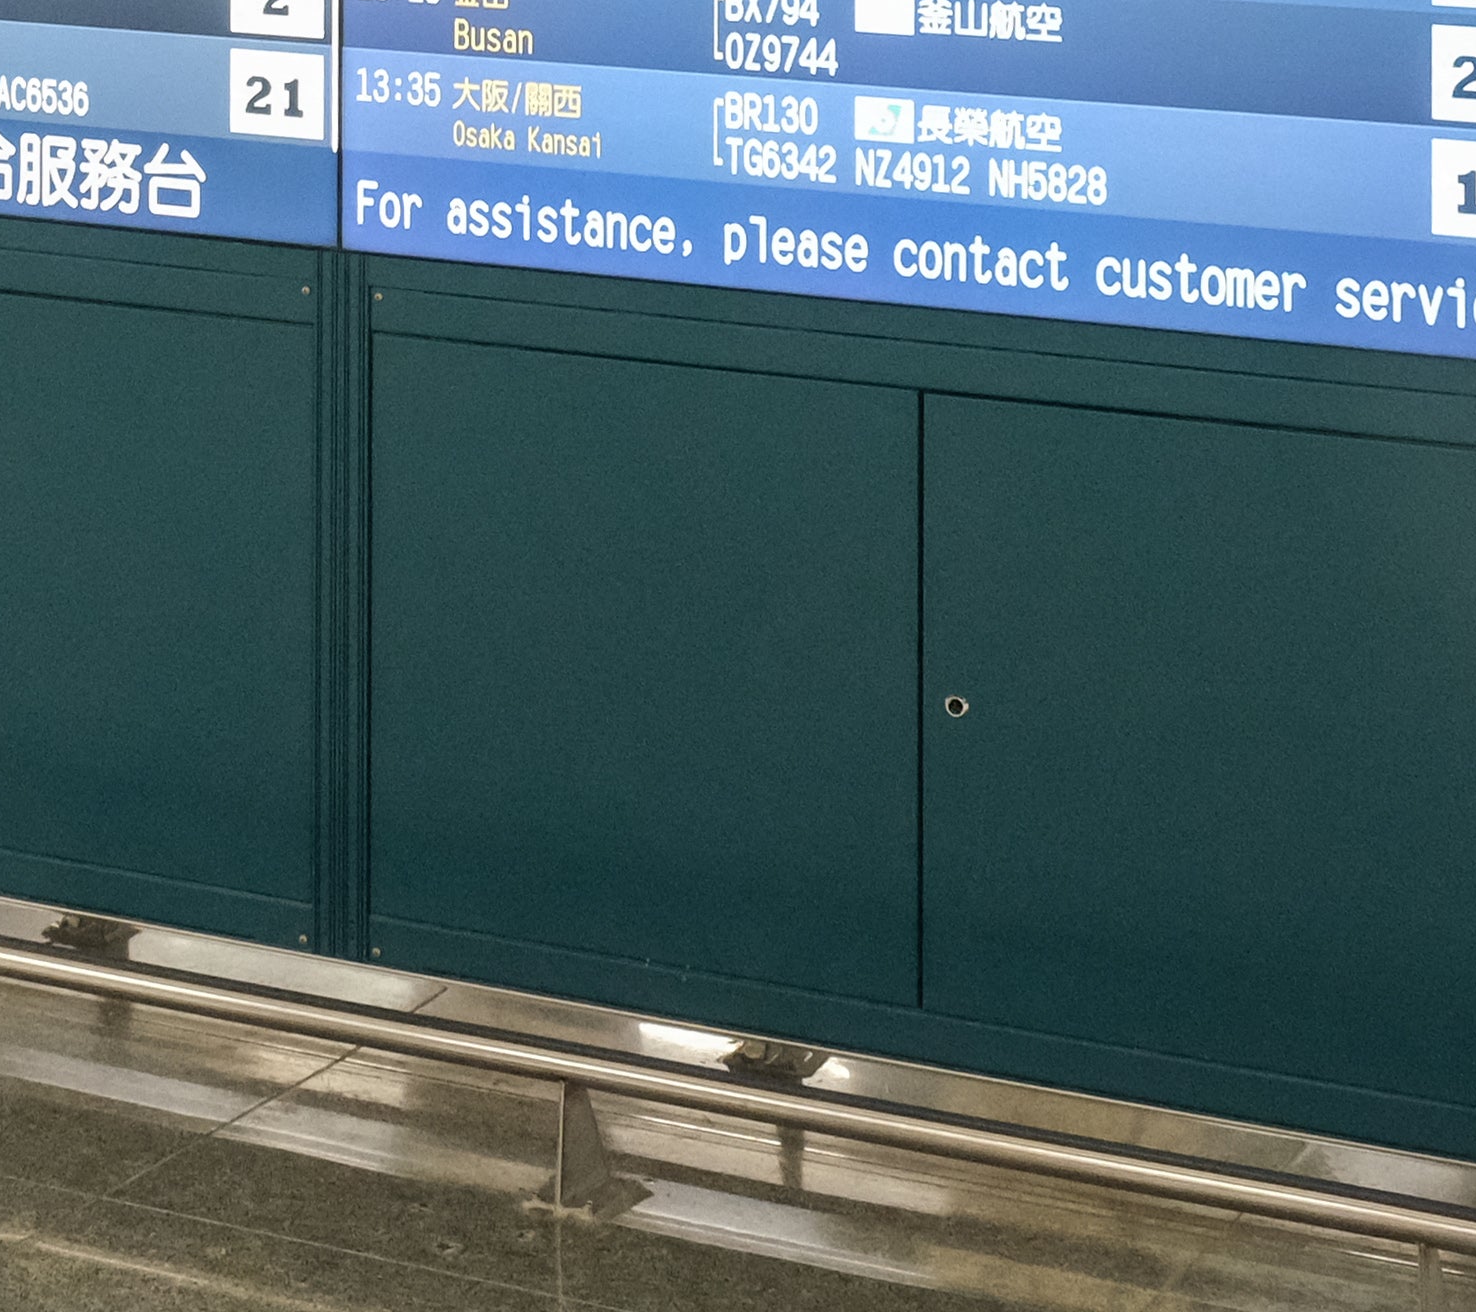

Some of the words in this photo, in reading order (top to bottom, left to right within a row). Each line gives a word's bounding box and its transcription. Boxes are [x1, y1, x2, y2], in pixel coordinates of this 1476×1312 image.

[454, 17, 533, 55] Busan
[356, 67, 441, 107] 13:35
[355, 180, 422, 230] For
[447, 194, 693, 257] assistance,
[723, 215, 869, 273] please
[893, 235, 1069, 291] contact
[1096, 253, 1307, 313] customer
